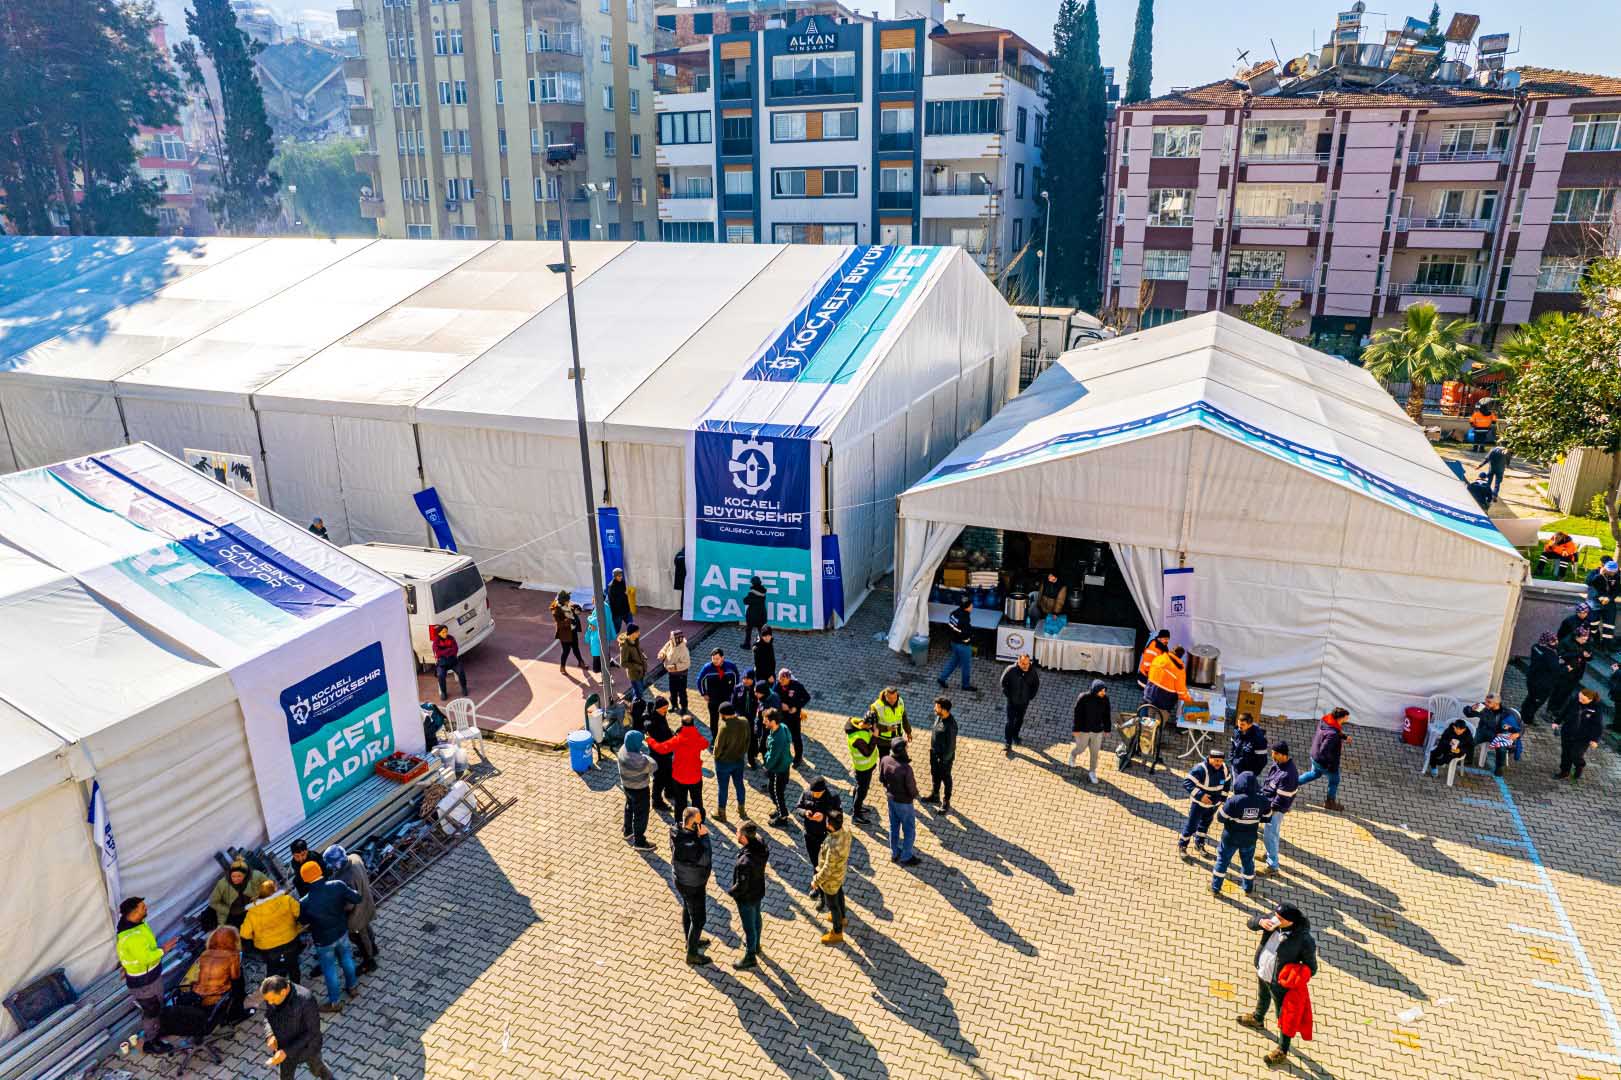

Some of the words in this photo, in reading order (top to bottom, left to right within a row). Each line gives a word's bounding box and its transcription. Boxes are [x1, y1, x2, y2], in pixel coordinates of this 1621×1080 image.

[790, 33, 835, 47] ALKAN
[218, 549, 282, 588] OLUYOR
[701, 564, 806, 597] AFET
[700, 595, 807, 623] ÇAIRI
[303, 707, 386, 778] AFET
[306, 735, 390, 802] ÇADIRI
